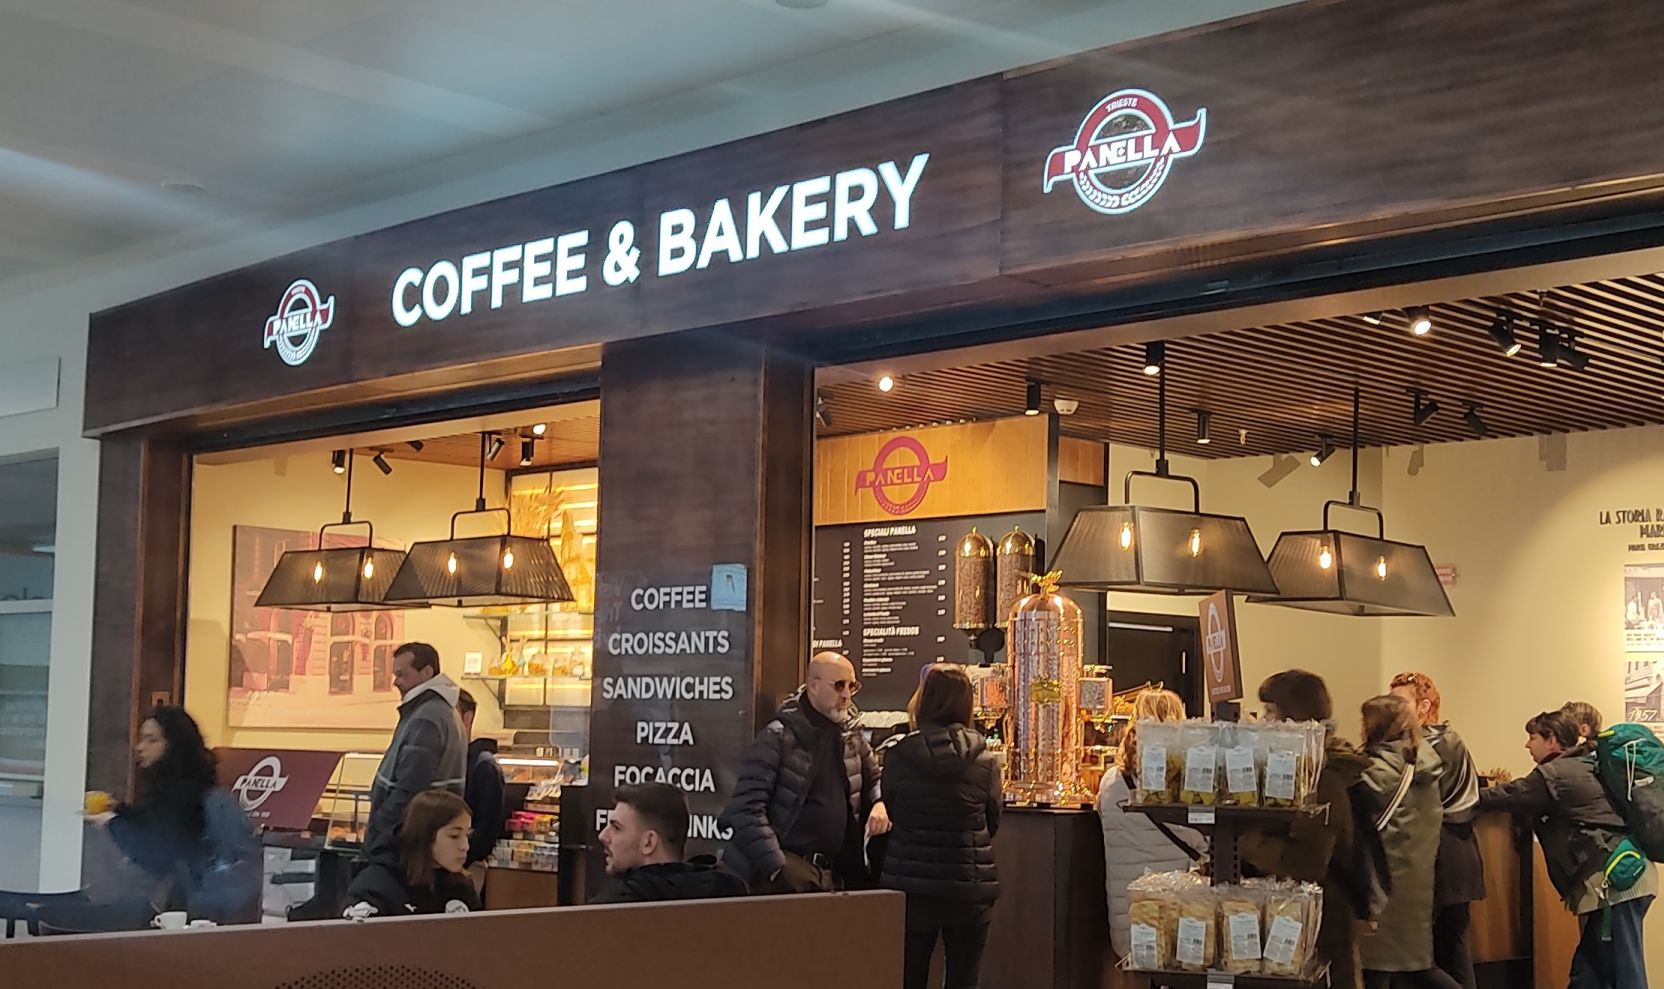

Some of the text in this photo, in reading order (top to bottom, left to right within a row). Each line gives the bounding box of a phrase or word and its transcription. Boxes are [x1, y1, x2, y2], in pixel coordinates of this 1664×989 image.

[1105, 97, 1139, 113] TRIESTE
[1063, 130, 1182, 174] PANELLA
[391, 152, 930, 328] COFFEE & BAKERY
[272, 309, 323, 336] PANELLA
[866, 466, 934, 487] PANELLA
[1599, 511, 1611, 525] LA
[1615, 508, 1652, 524] STORIA
[630, 585, 708, 611] COFFEE
[607, 630, 730, 656] CROISSANTS
[601, 675, 734, 700] SANDWICHES
[635, 720, 695, 746] PIZZA
[240, 777, 277, 789] PANELLA
[613, 765, 716, 793] FOCACCIA
